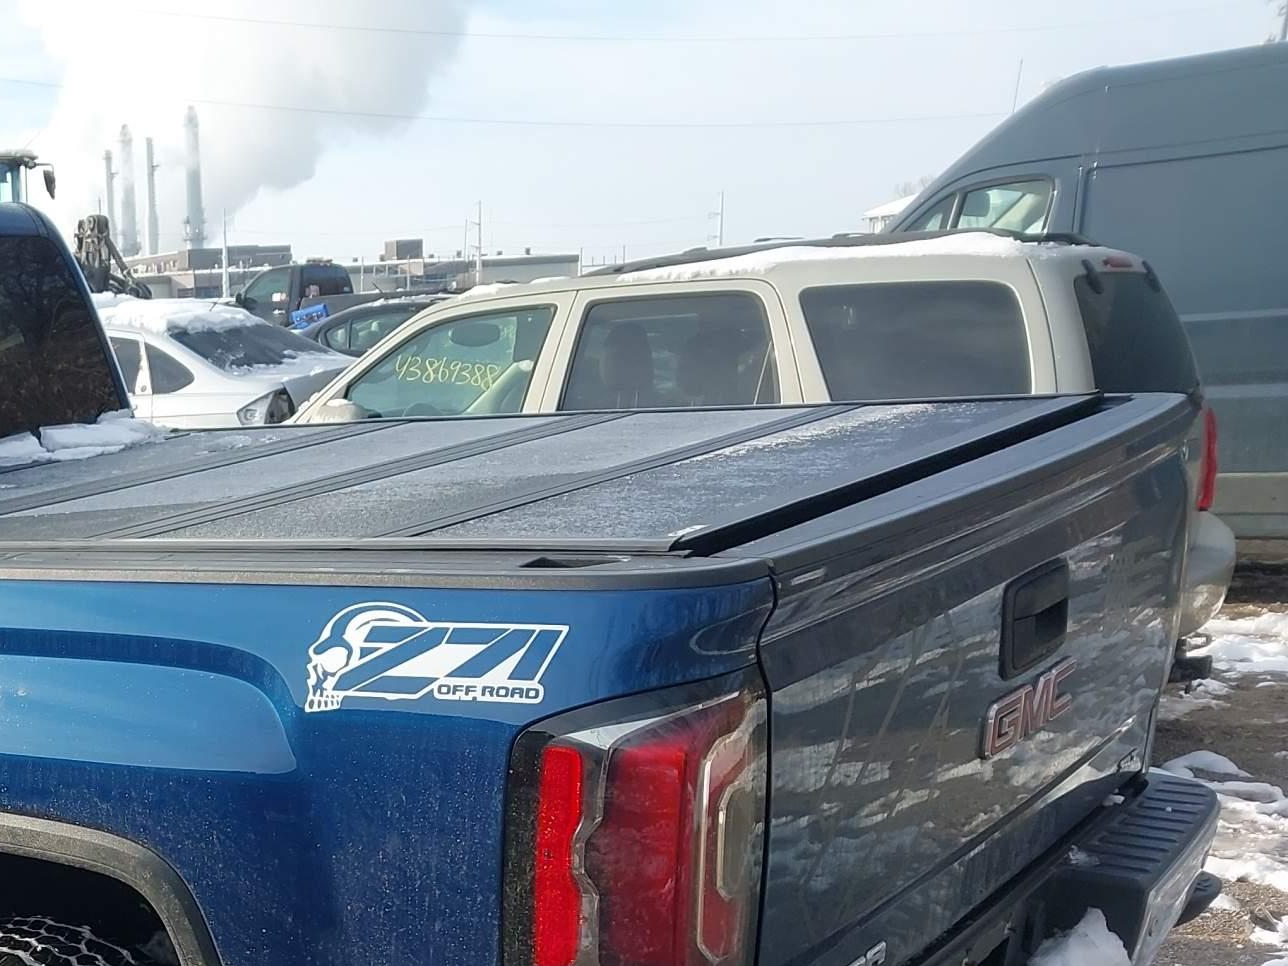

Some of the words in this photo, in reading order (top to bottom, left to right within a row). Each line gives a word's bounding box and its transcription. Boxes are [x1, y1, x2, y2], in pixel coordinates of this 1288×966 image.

[395, 354, 501, 392] 43869388
[437, 683, 477, 698] OFF
[480, 685, 541, 701] ROAD
[984, 656, 1078, 758] GMC
